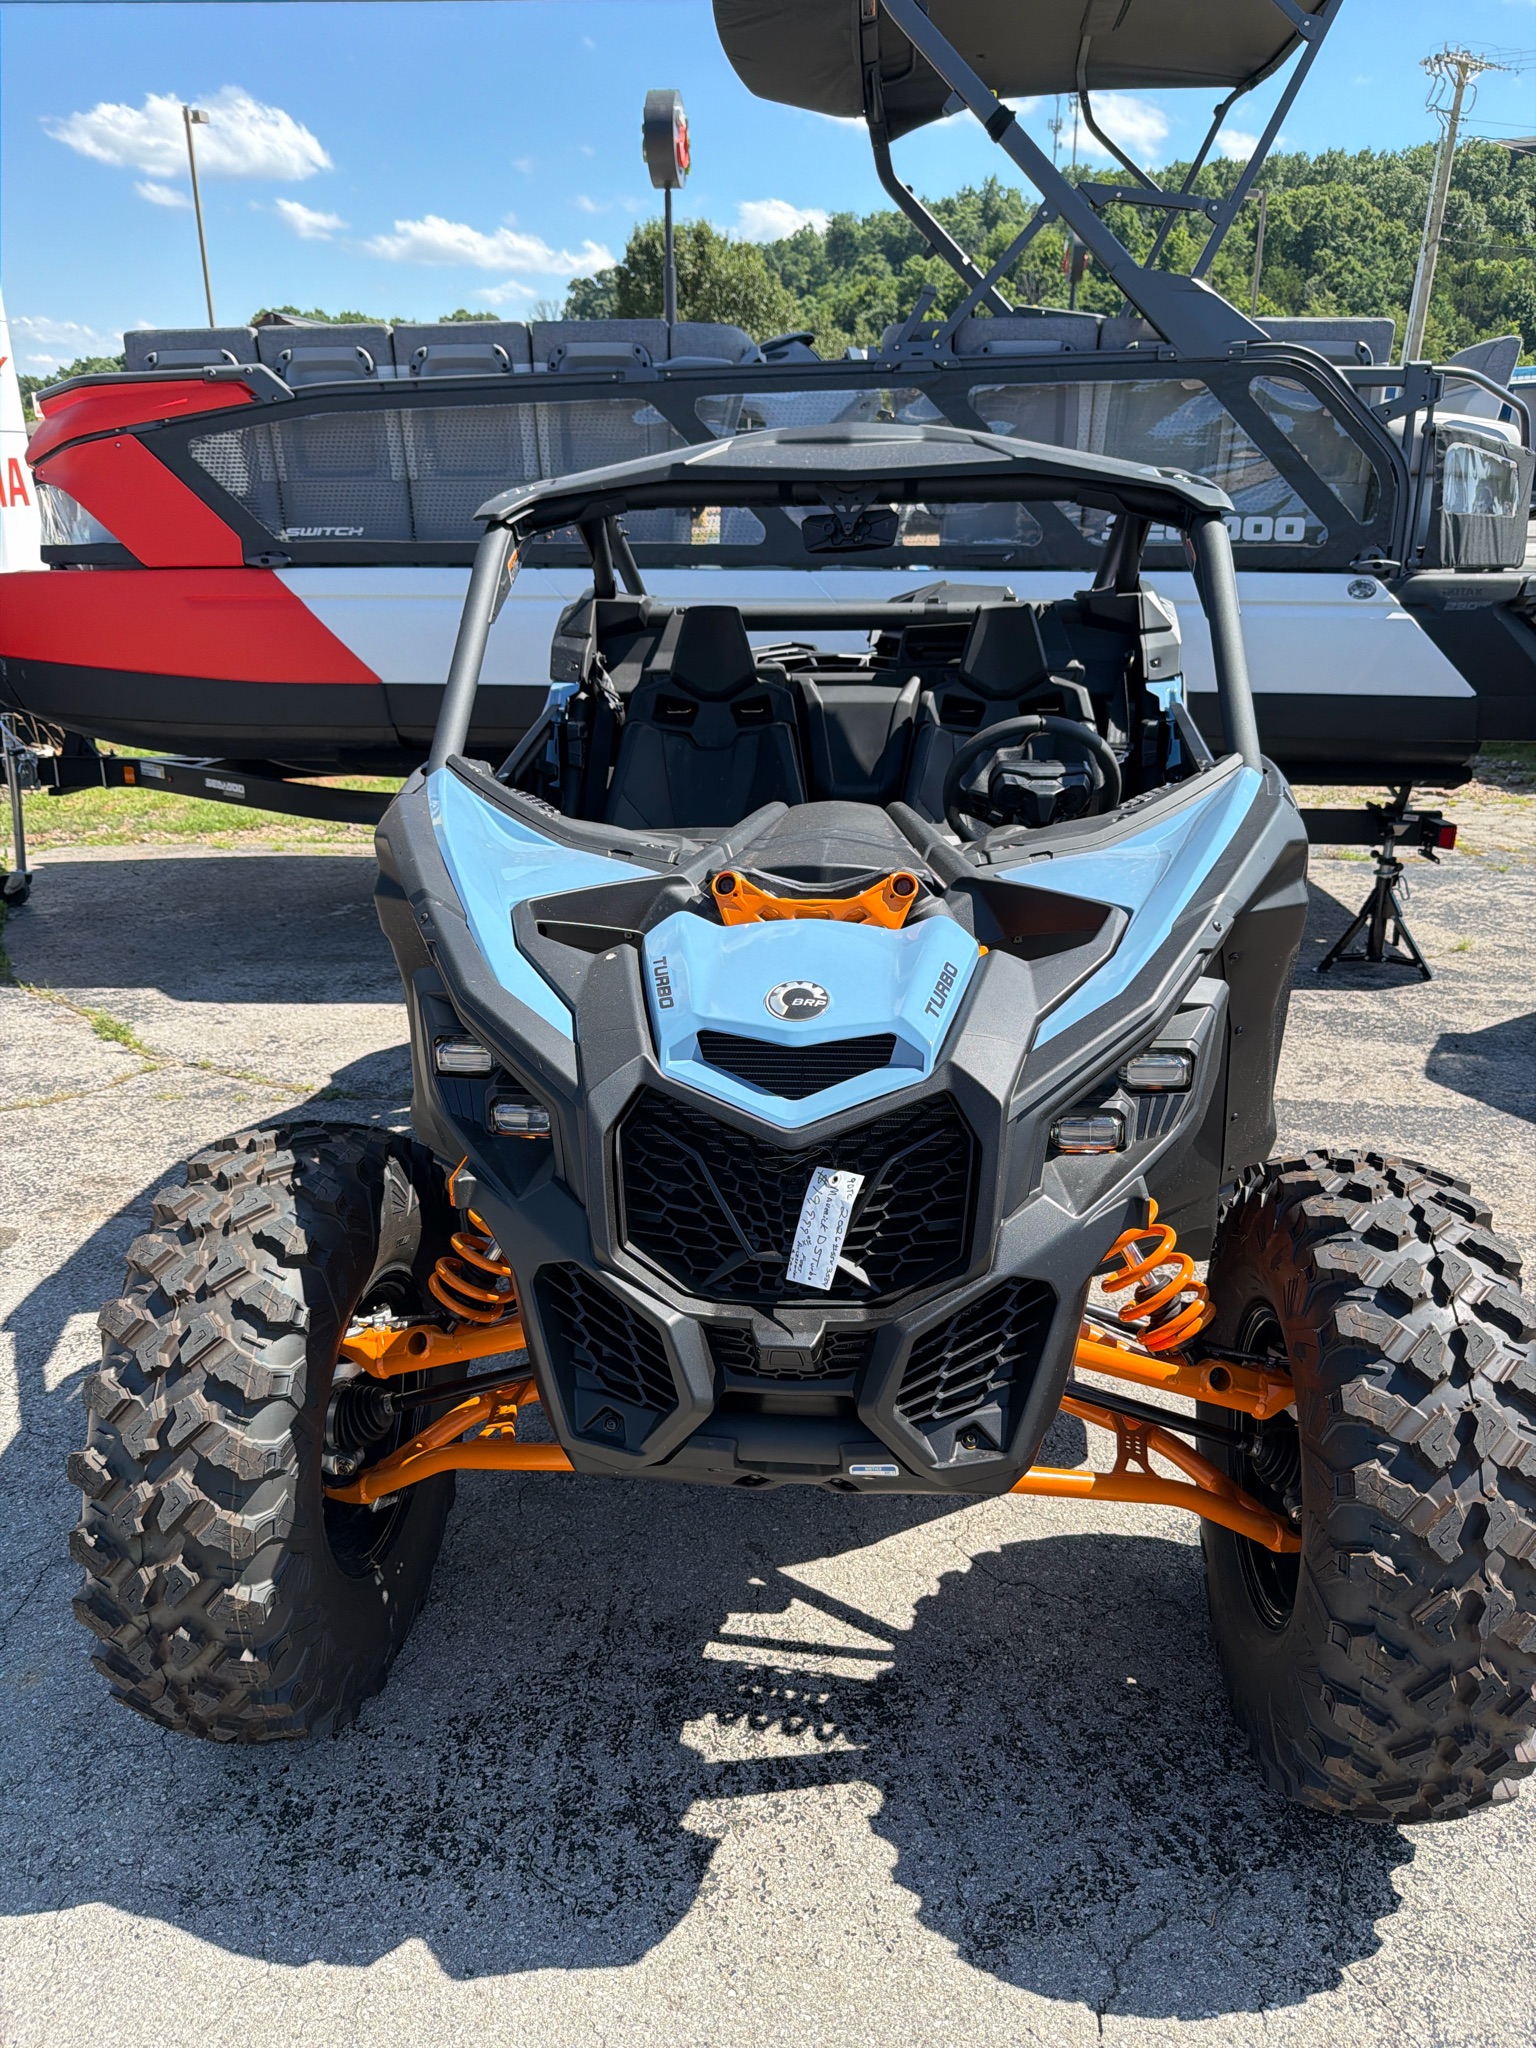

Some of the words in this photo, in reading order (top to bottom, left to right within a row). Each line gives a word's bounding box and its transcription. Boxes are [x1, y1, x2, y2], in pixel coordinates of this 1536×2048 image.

[286, 526, 364, 537] SWITCH
[652, 956, 673, 1010] TURBO
[924, 961, 958, 1018] TURBO
[792, 998, 827, 1008] BRP
[836, 1206, 849, 1242] 2026
